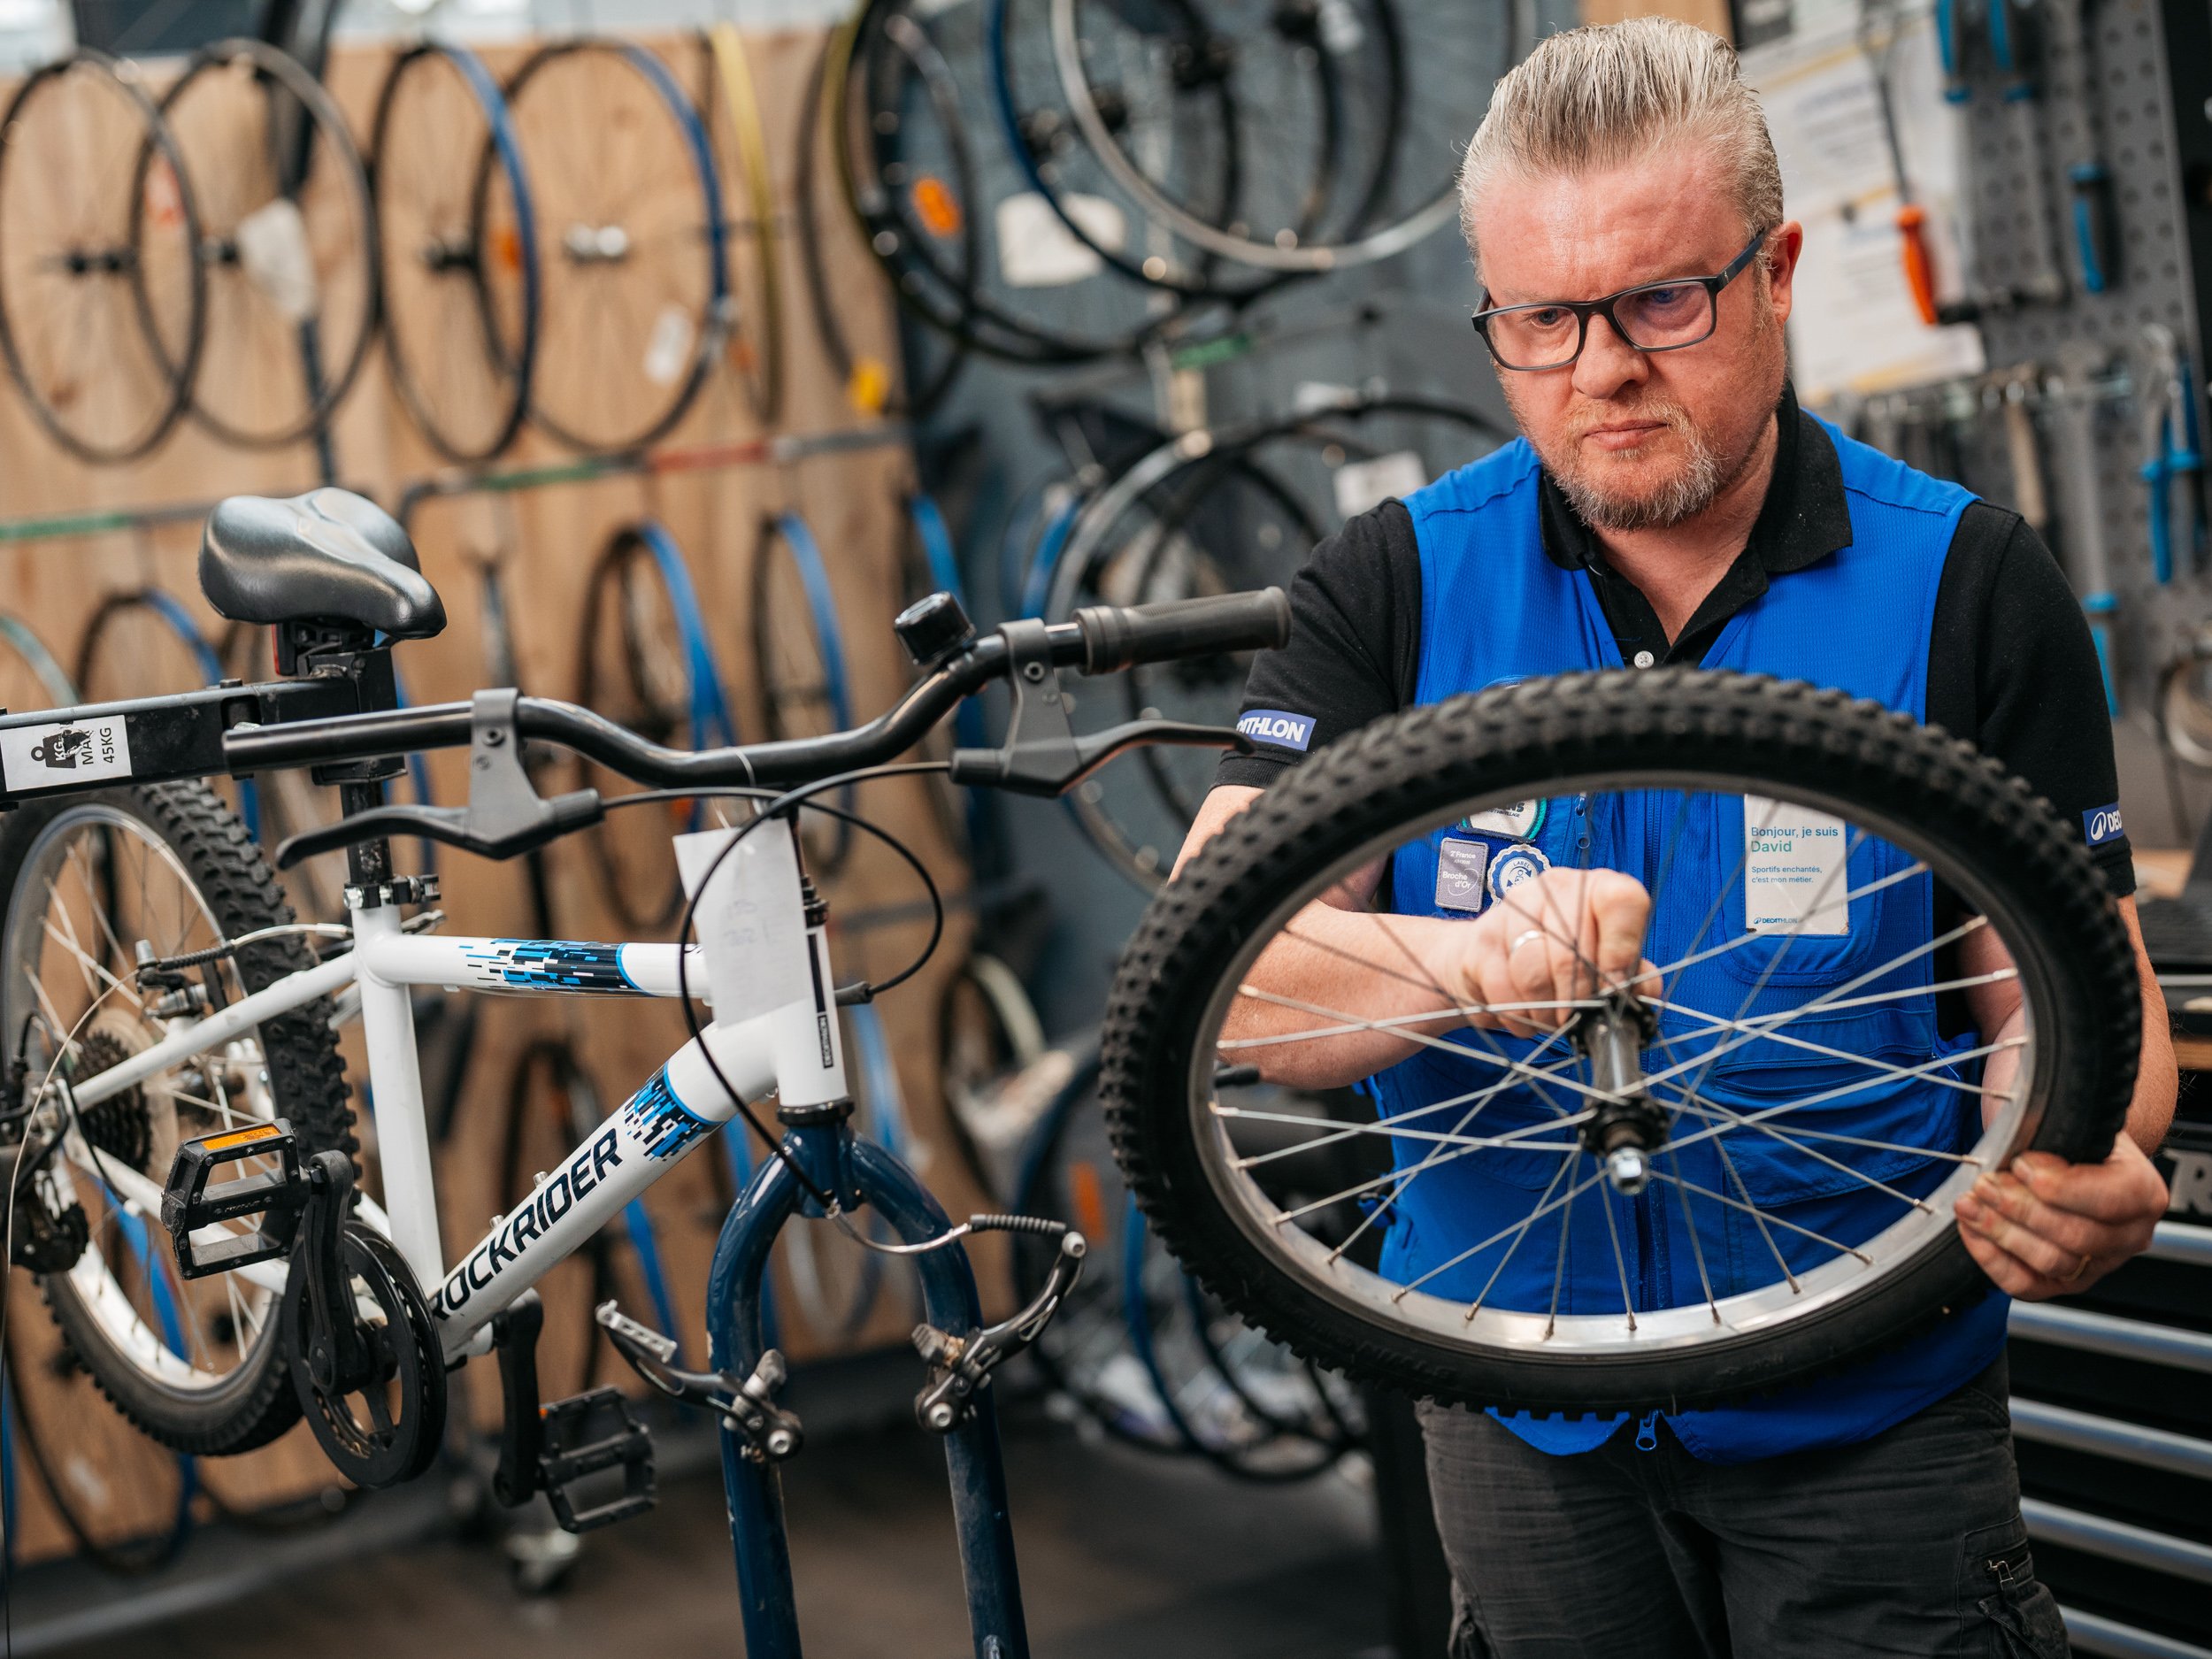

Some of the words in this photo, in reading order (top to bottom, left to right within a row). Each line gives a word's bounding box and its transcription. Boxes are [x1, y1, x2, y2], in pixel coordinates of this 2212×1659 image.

[100, 727, 114, 764] 45KG
[1751, 826, 1799, 838] Bonjour,
[1801, 826, 1812, 838] je
[1815, 826, 1839, 837] suis
[1751, 841, 1792, 852] David
[1442, 872, 1467, 880] Broche
